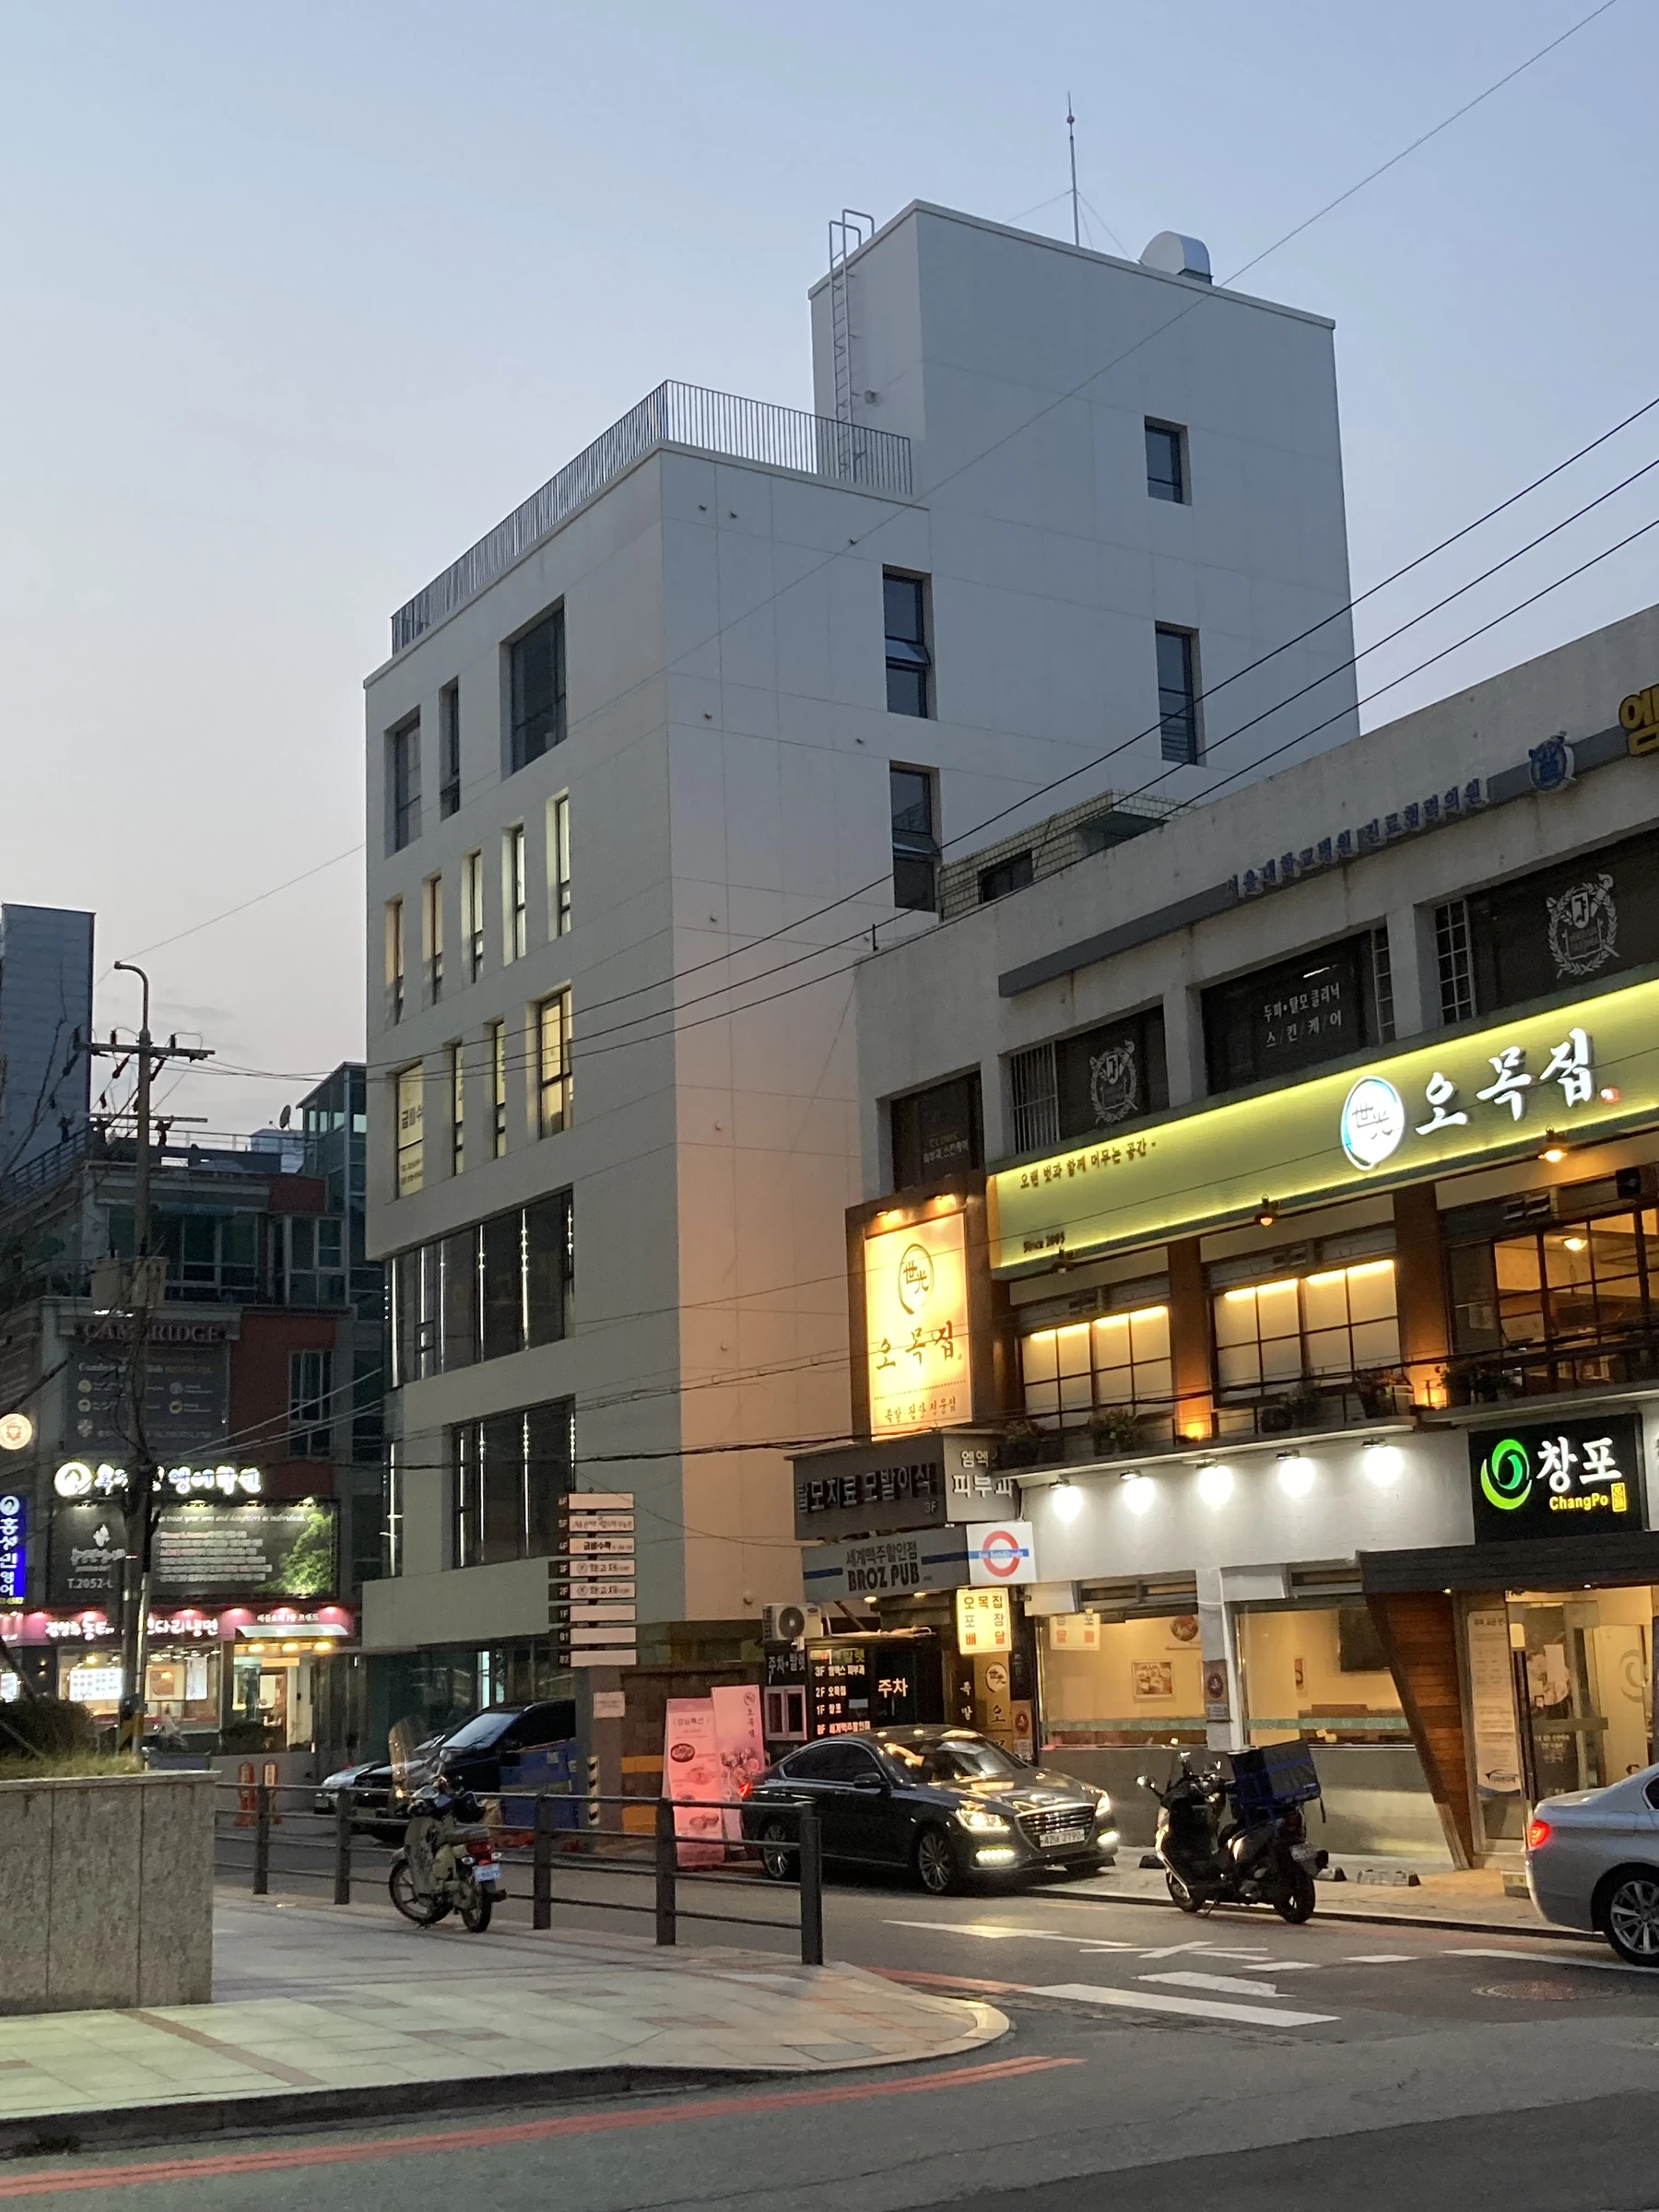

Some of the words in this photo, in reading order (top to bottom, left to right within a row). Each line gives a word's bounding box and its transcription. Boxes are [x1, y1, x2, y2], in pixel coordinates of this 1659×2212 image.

[1415, 1028, 1595, 1135] 오목집
[1066, 1155, 1086, 1178] 함께
[1125, 1137, 1147, 1161] 공간
[83, 1324, 220, 1343] CAMRIDGE
[876, 1320, 955, 1371] 오목집
[1536, 1436, 1623, 1493] 창포
[952, 1475, 1015, 1499] 피부과
[924, 1501, 936, 1513] 3F
[1549, 1492, 1609, 1511] ChangPo
[846, 1541, 918, 1566] 세계맥주할인점
[847, 1567, 888, 1592] BROZ
[890, 1562, 920, 1588] PUB
[963, 1595, 1003, 1610] 오목집
[965, 1613, 1005, 1628] 포장
[965, 1630, 1006, 1646] 배달
[815, 1666, 826, 1677] 3F
[815, 1688, 826, 1699] 2F
[828, 1686, 847, 1697] 오목집
[877, 1678, 909, 1698] 주차
[816, 1705, 826, 1716] 1F
